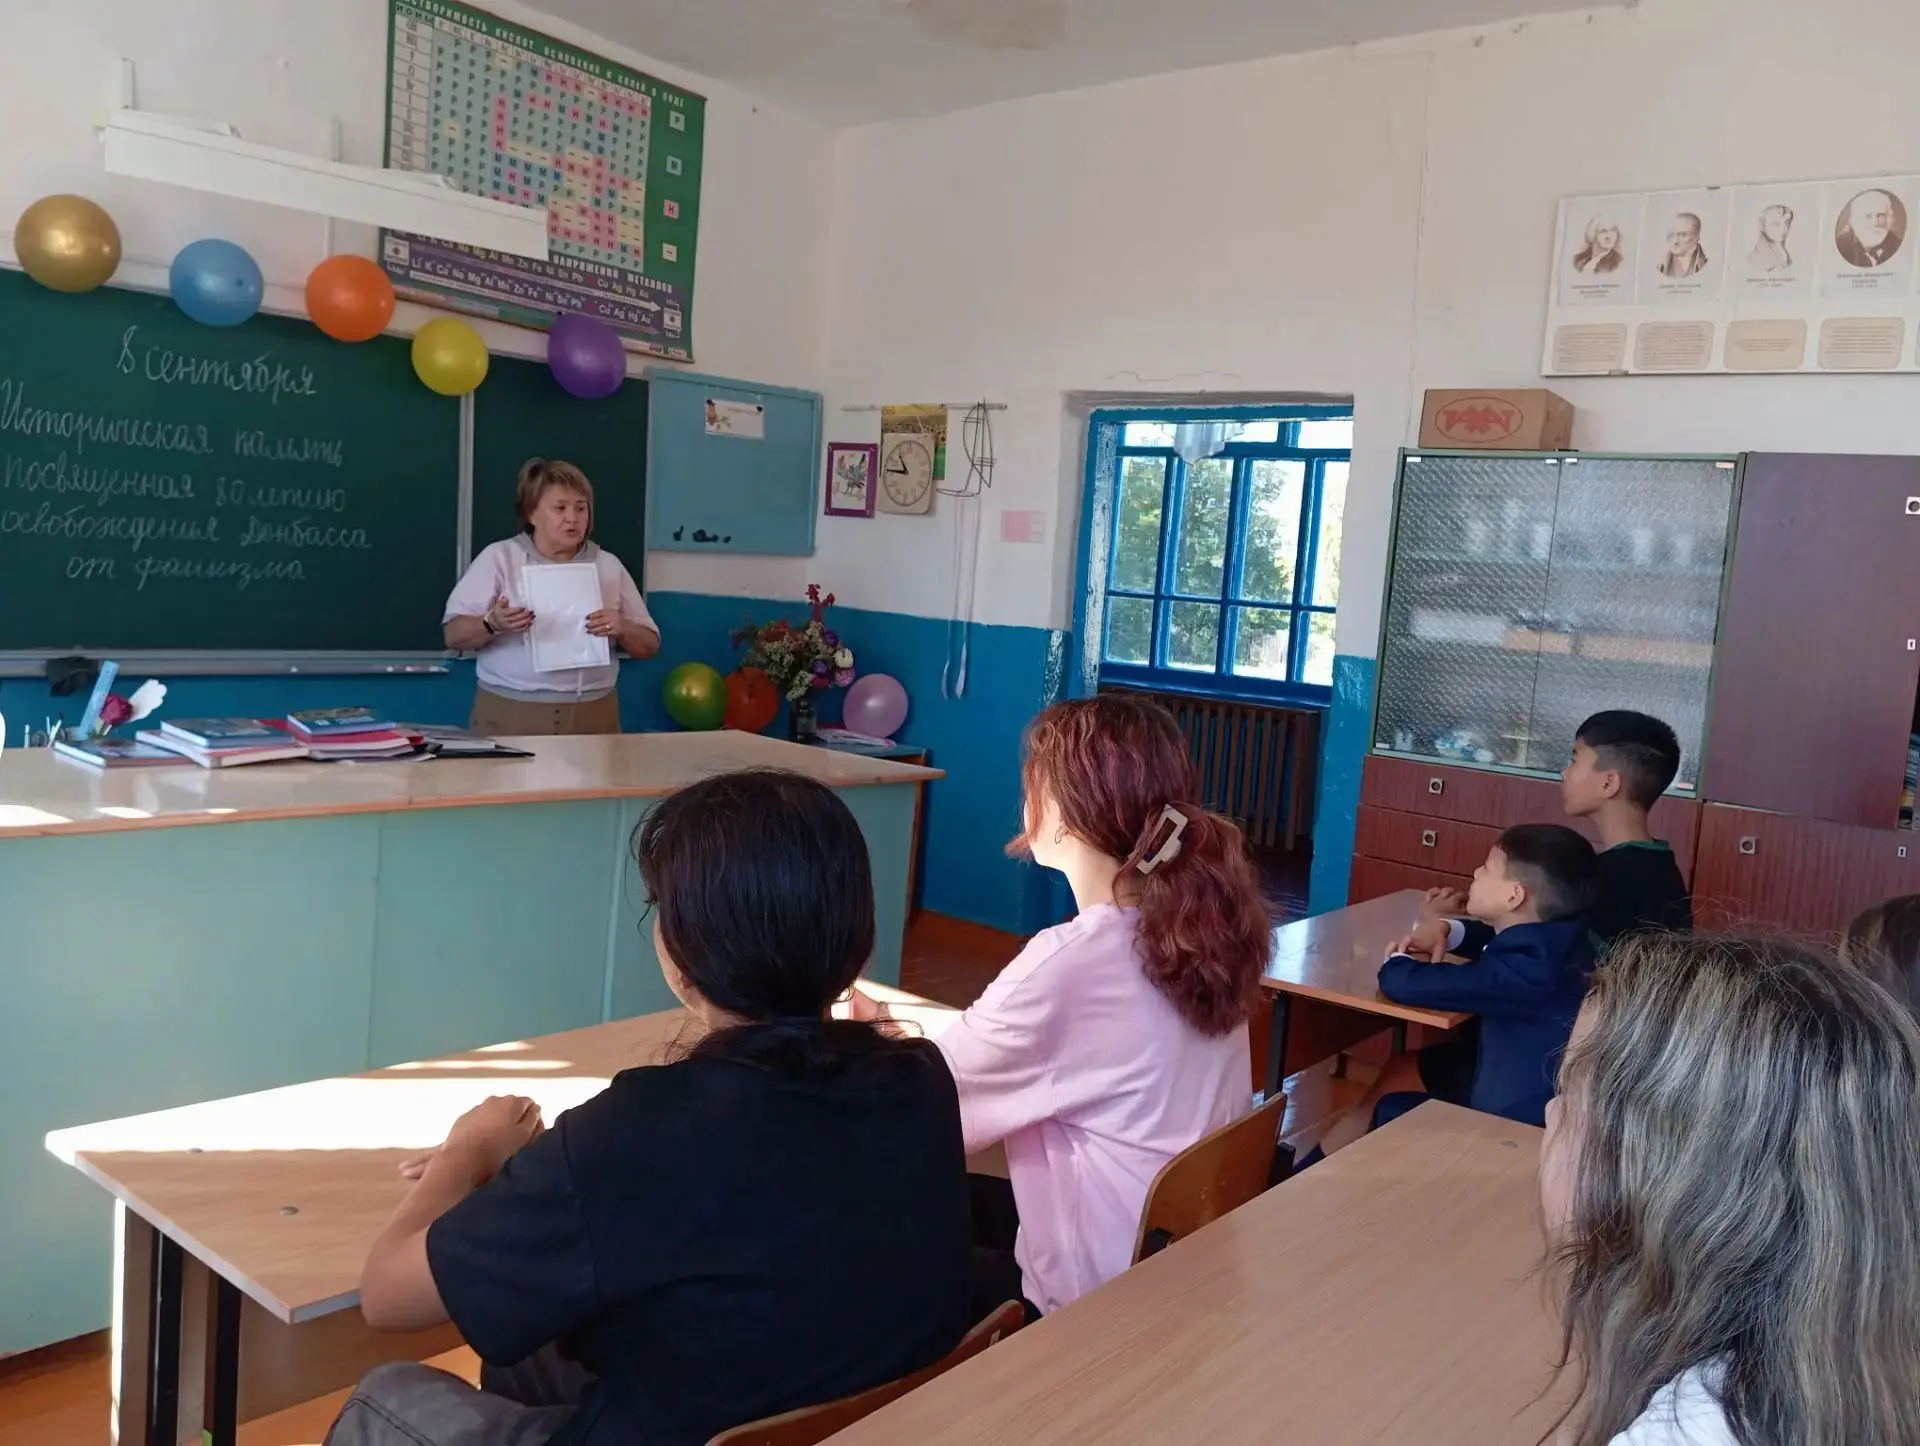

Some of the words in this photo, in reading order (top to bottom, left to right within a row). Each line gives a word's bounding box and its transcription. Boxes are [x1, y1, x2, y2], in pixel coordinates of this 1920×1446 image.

[117, 324, 138, 374] 8
[0, 376, 214, 455] Историческая
[1, 501, 220, 552] освобождения
[240, 514, 373, 547] Донбасса
[66, 556, 117, 579] от
